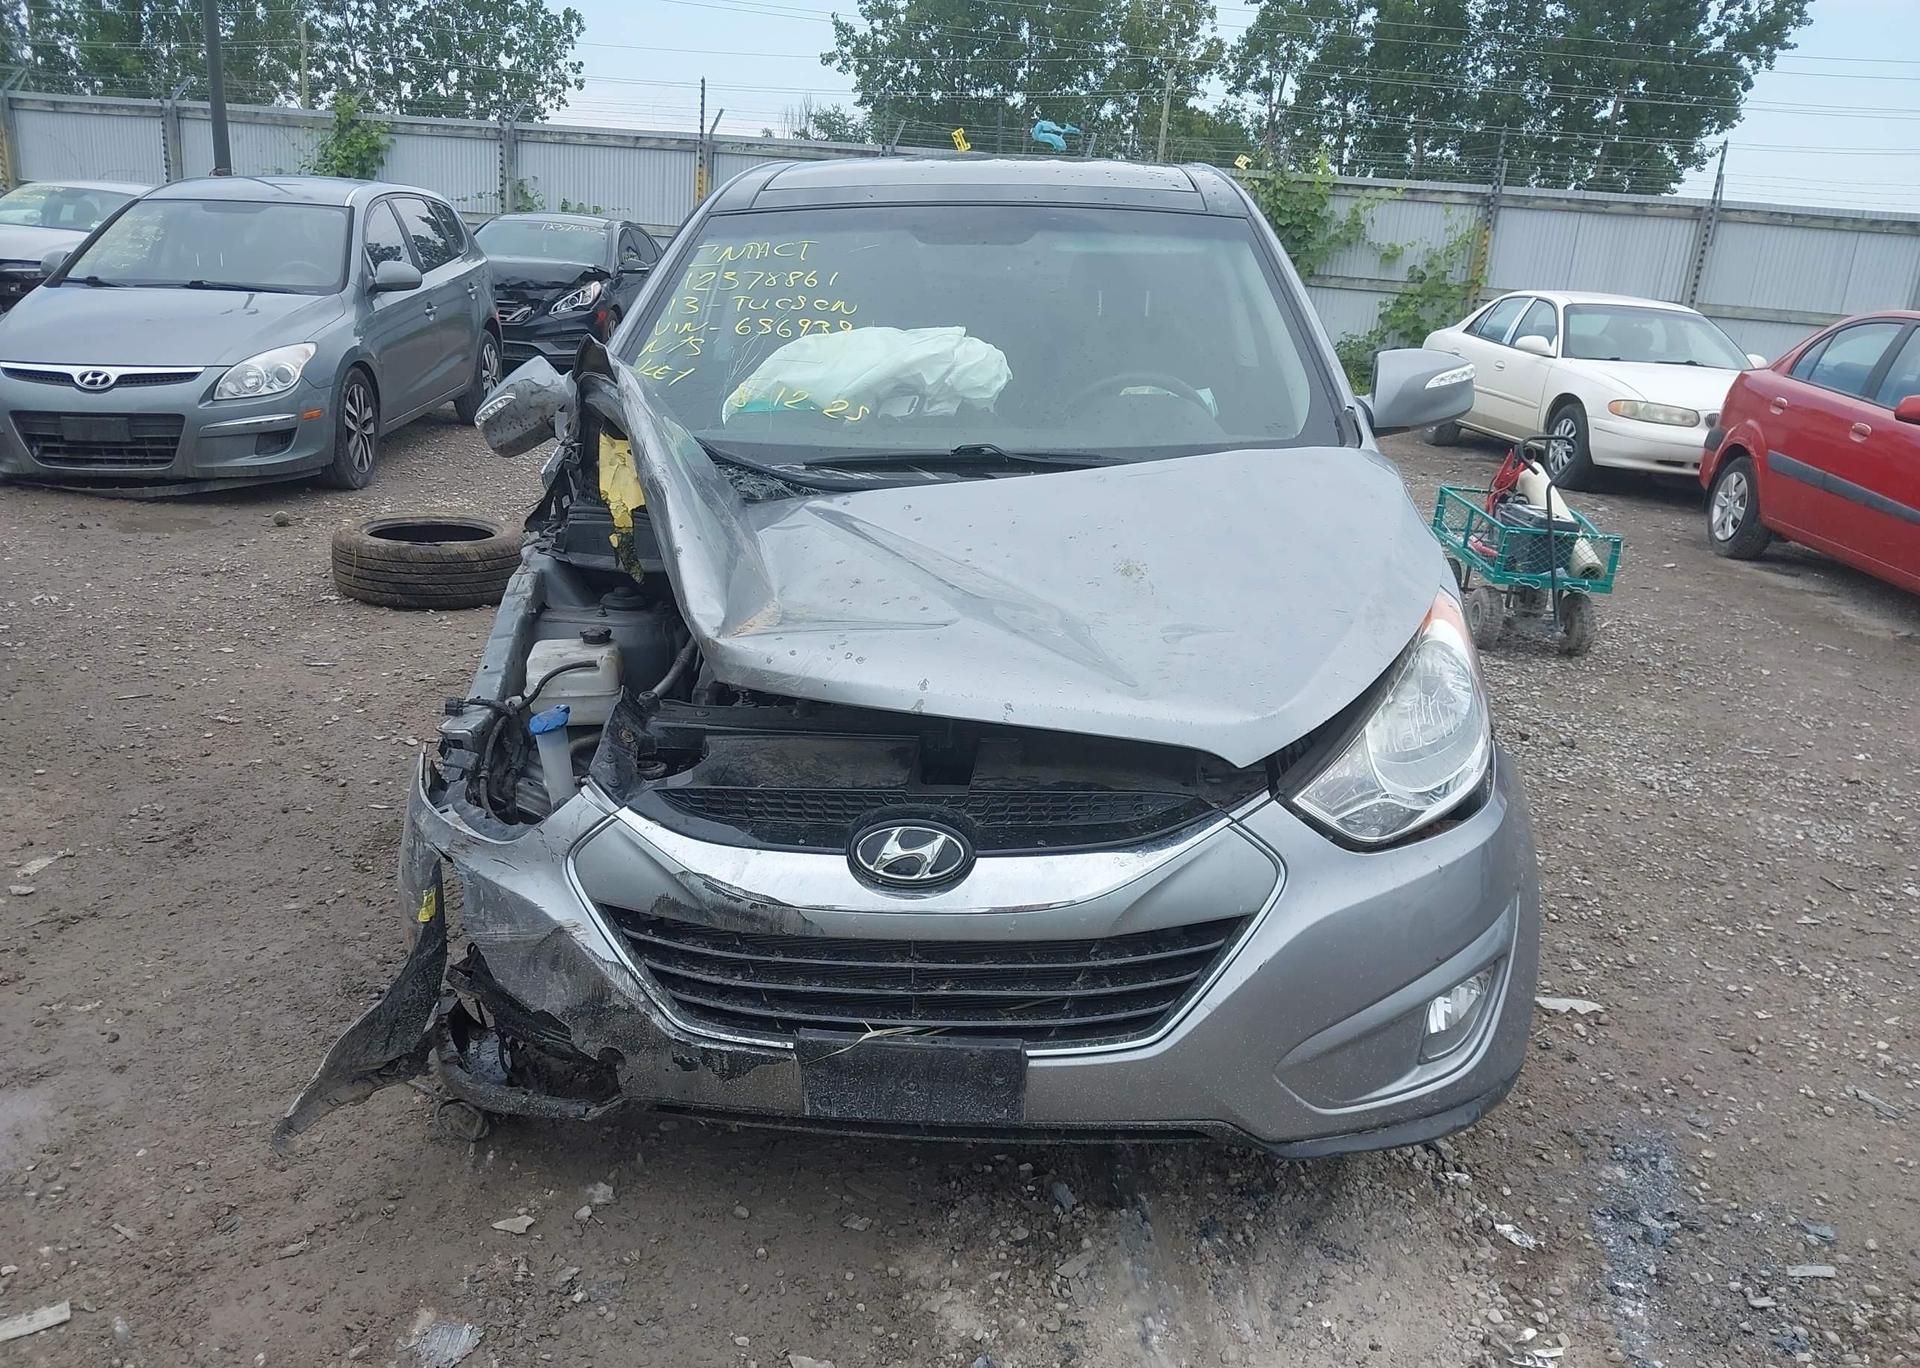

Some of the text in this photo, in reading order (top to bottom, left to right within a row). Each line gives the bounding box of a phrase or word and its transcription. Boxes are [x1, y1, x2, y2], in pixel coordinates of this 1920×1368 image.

[687, 240, 820, 268] INTACT
[684, 271, 839, 292] 12378861
[638, 358, 697, 387] KEY
